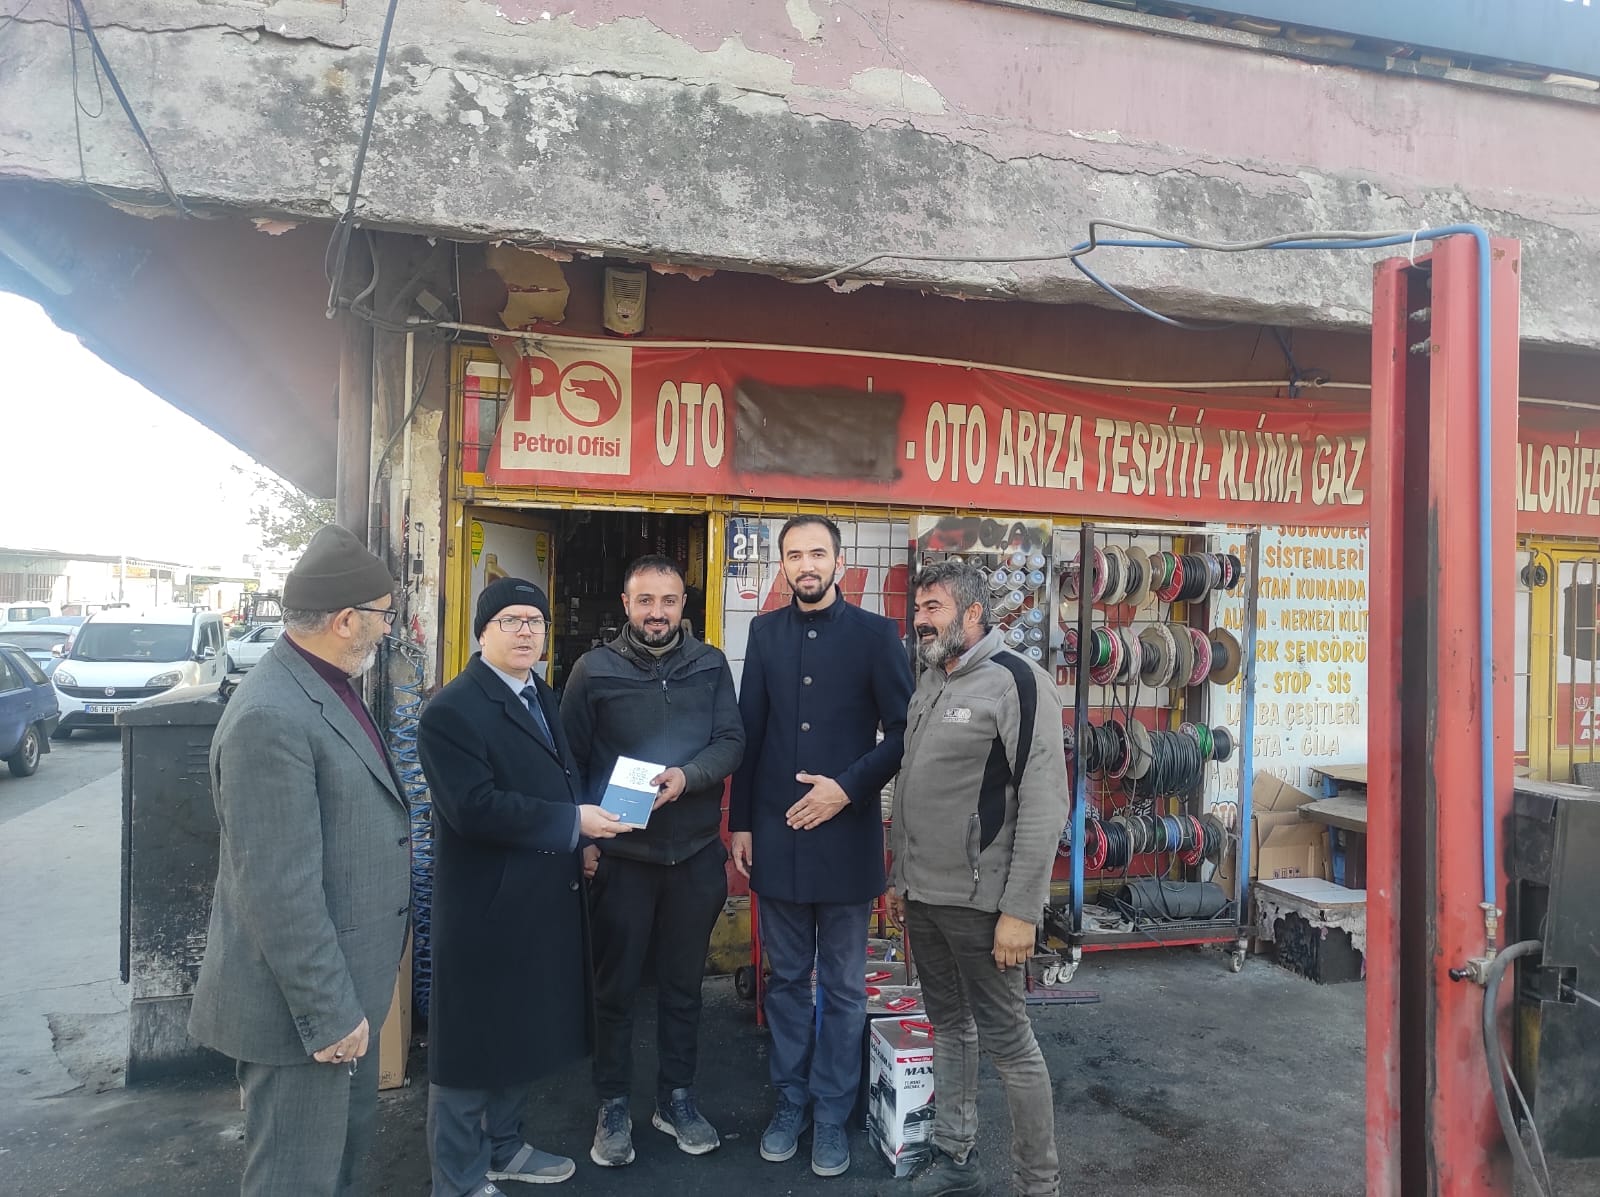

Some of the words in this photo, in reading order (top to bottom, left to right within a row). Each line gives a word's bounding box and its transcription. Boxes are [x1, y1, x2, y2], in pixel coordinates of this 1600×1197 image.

[513, 431, 573, 455] Petrol
[577, 435, 621, 458] Ofisi
[655, 379, 726, 469] OTO
[924, 400, 987, 484] OTO
[994, 407, 1084, 491] ARIZA
[1311, 433, 1367, 506] GAZ
[733, 533, 759, 559] 21
[1265, 539, 1365, 571] SİSTEMLERİ
[1296, 577, 1366, 602] KUMANDA
[1280, 603, 1335, 632] MERKEZİ
[1284, 634, 1367, 663] SENSÖRÜ
[1273, 670, 1312, 695] STOP
[1327, 665, 1352, 695] SİS
[1285, 696, 1360, 731] ÇEŞİTLERİ
